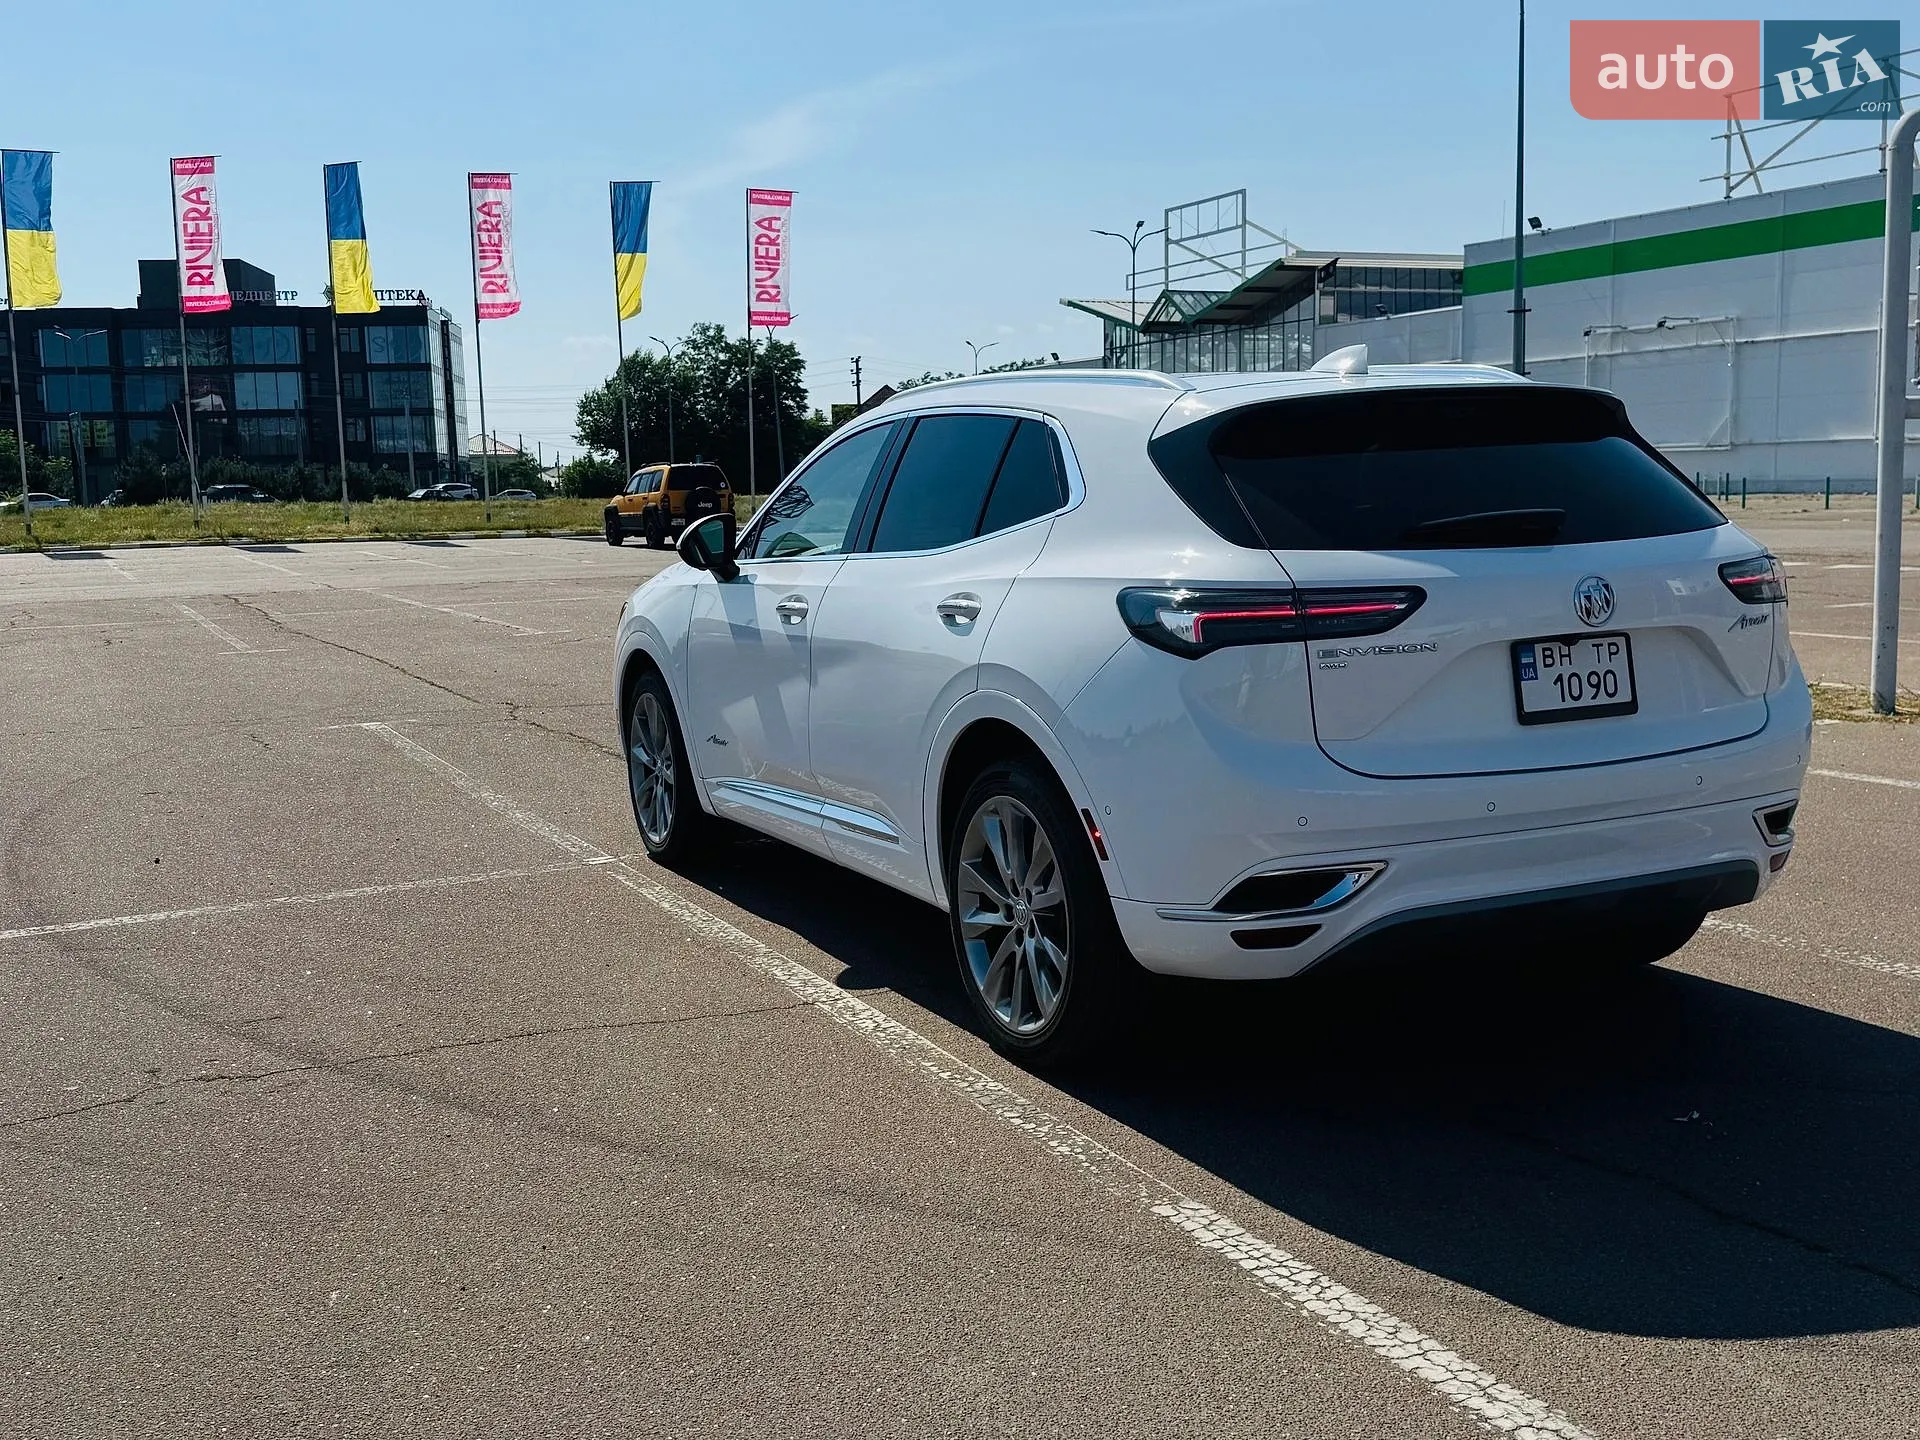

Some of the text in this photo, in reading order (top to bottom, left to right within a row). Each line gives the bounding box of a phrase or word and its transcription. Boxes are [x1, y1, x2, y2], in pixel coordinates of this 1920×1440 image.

[181, 186, 215, 287] RIVIERA
[476, 200, 510, 294] RIVIERA
[754, 216, 781, 303] RIVIERA
[373, 289, 426, 301] ПТЕКА
[1317, 643, 1438, 659] ENVISION
[1541, 641, 1620, 668] BH TP
[1521, 667, 1536, 679] UA
[1552, 669, 1619, 703] 1090
